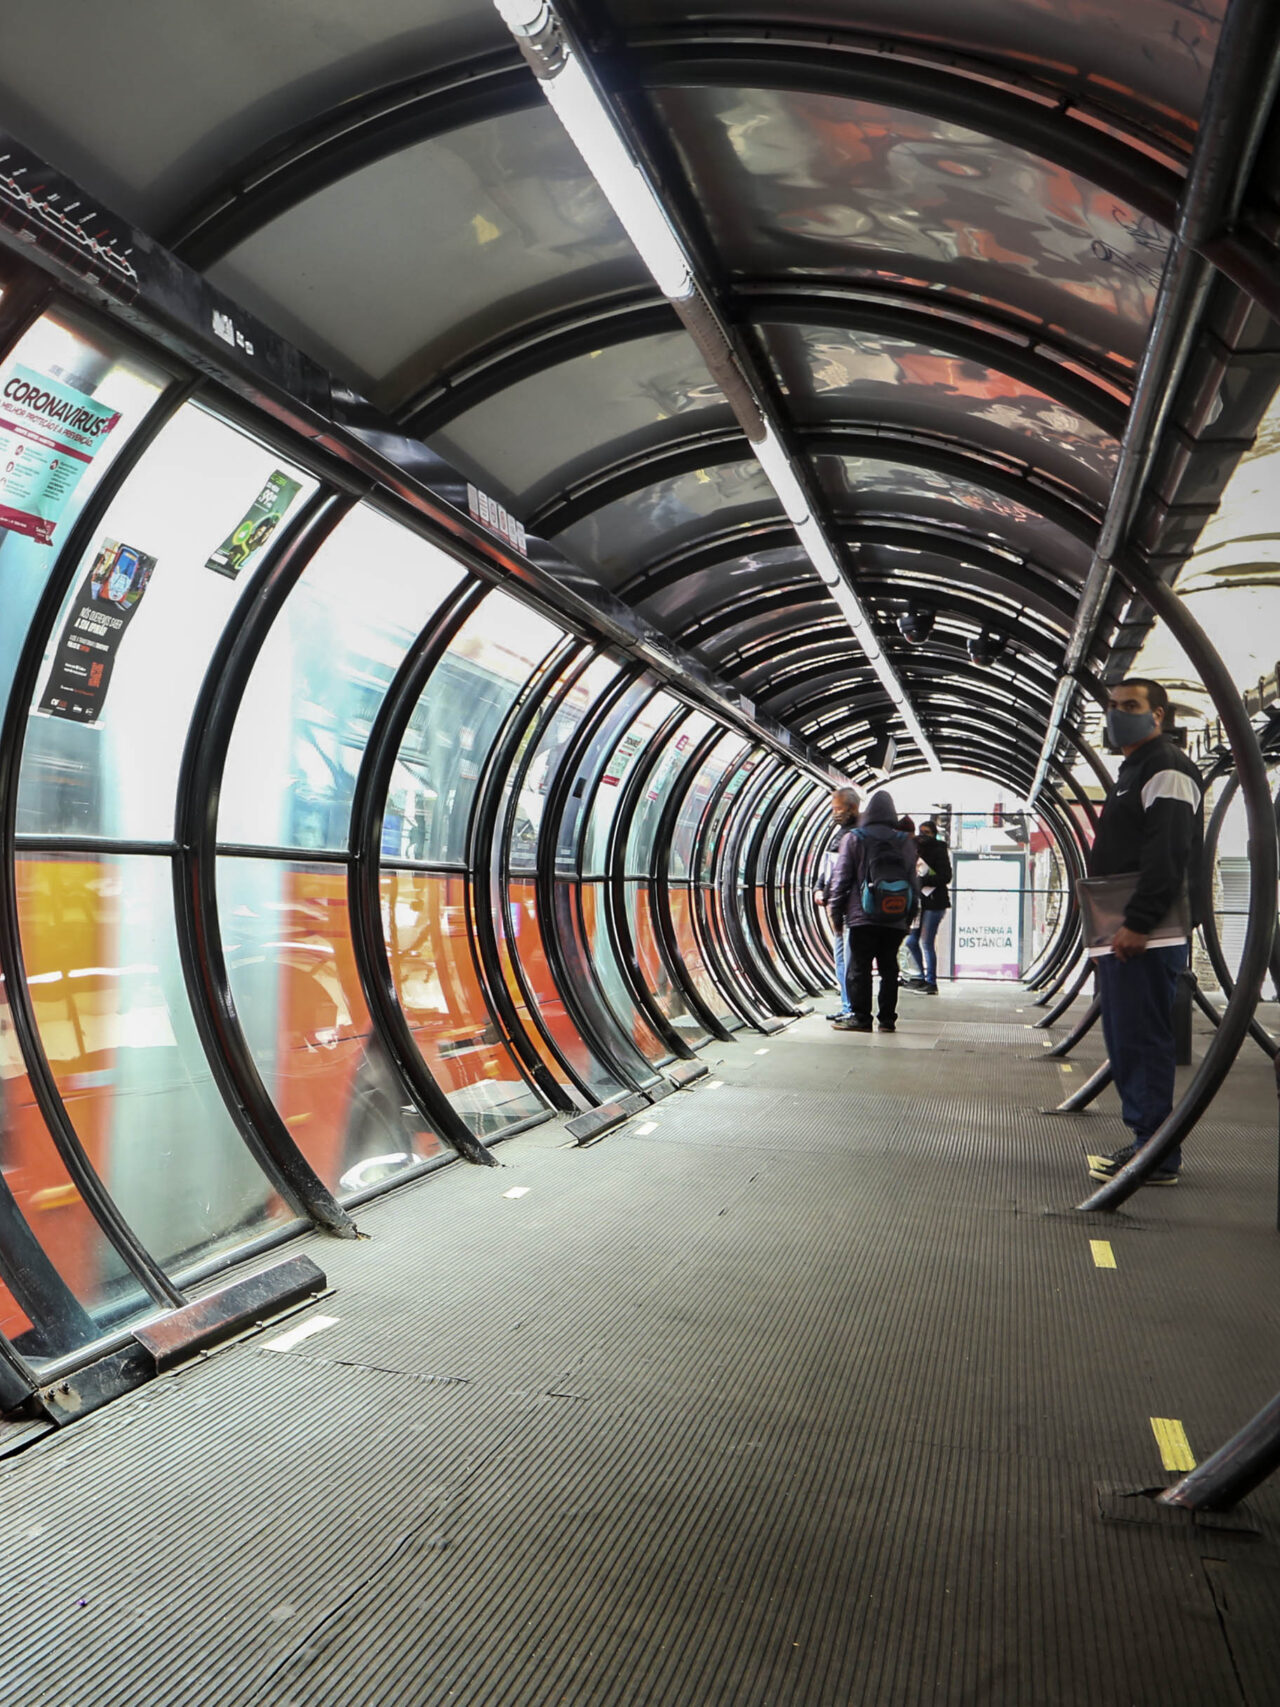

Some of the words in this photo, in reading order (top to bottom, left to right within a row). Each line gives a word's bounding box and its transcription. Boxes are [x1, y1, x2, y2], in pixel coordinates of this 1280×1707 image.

[3, 378, 106, 436] CORONAVÍRUS
[959, 926, 1005, 934] MANTENHA
[1007, 926, 1013, 934] A
